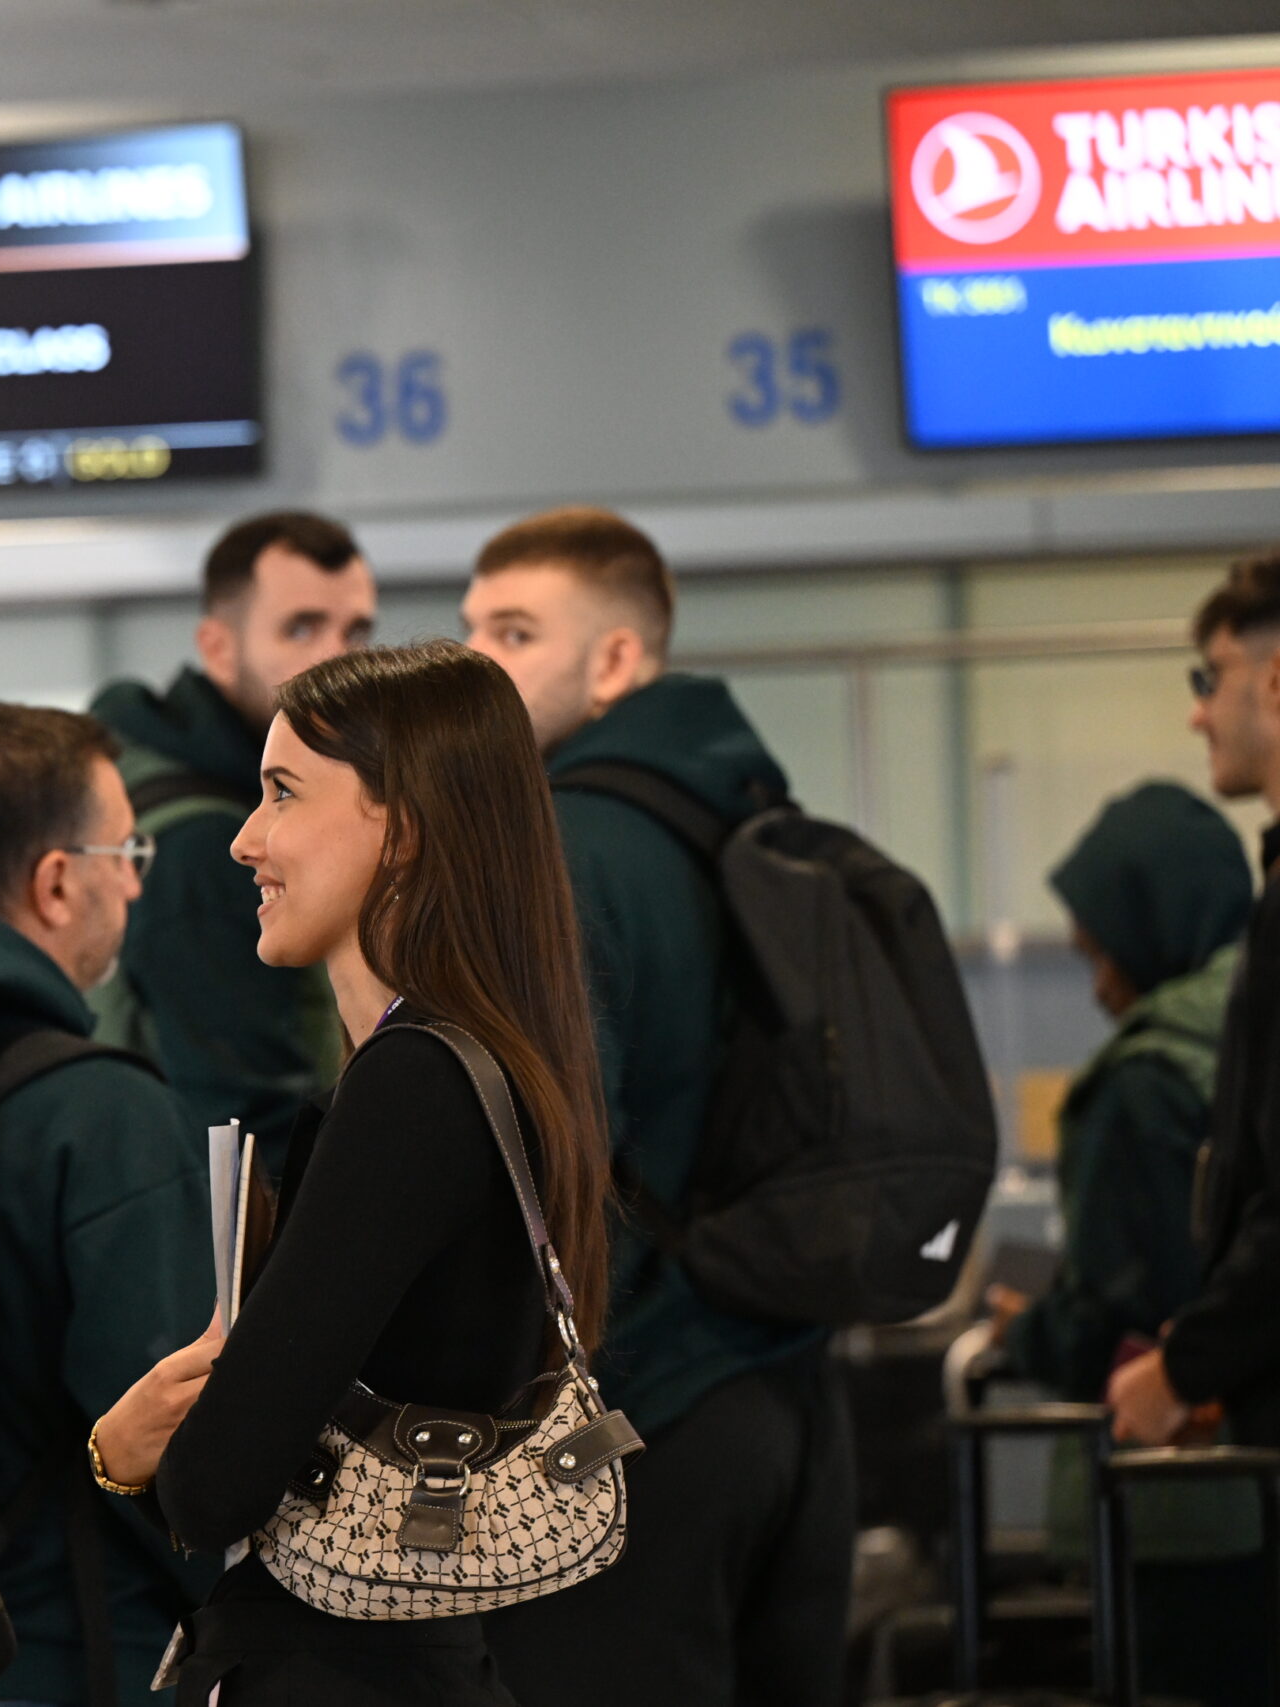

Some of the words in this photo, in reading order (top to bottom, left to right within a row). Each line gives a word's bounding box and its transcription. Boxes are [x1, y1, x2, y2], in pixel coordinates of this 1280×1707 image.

[1055, 163, 1280, 233] AIRLIN
[333, 348, 447, 448] 36
[726, 327, 842, 428] 35
